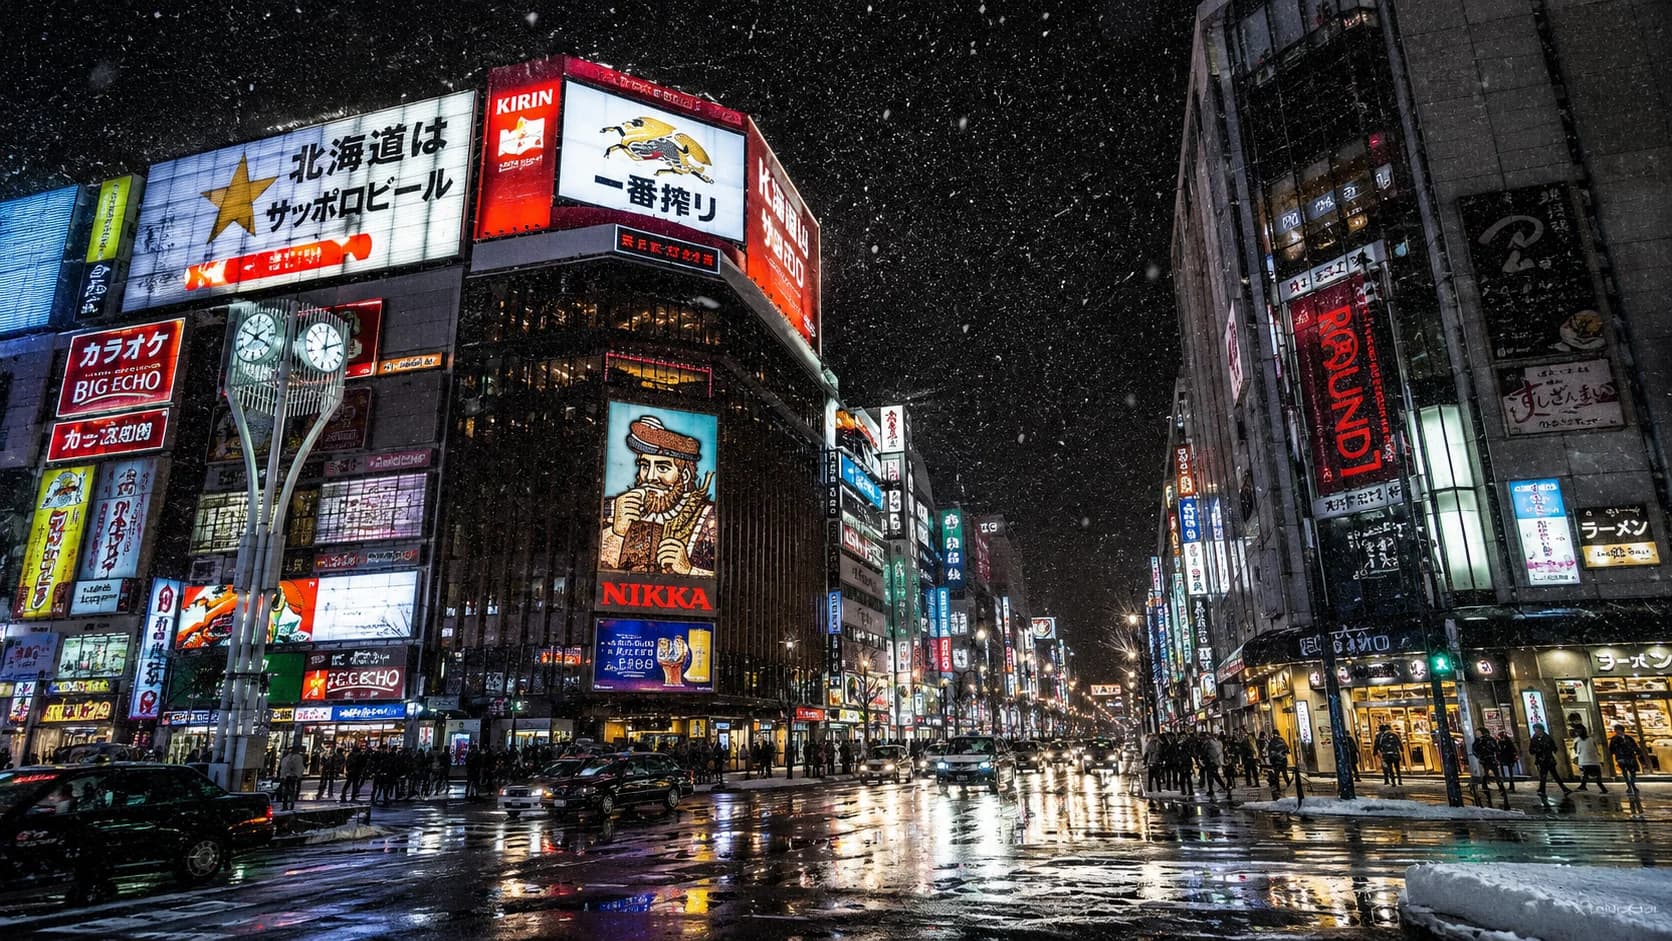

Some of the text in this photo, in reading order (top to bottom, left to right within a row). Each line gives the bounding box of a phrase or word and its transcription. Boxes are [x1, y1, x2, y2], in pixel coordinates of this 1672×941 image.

[496, 88, 553, 116] KIRIN
[289, 116, 449, 185] 北海道は
[266, 168, 455, 233] サッポロビール
[80, 331, 168, 368] カラオケ
[73, 370, 161, 403] BIG ECHO
[1581, 519, 1648, 539] ラーメン
[601, 581, 713, 611] NIKKA
